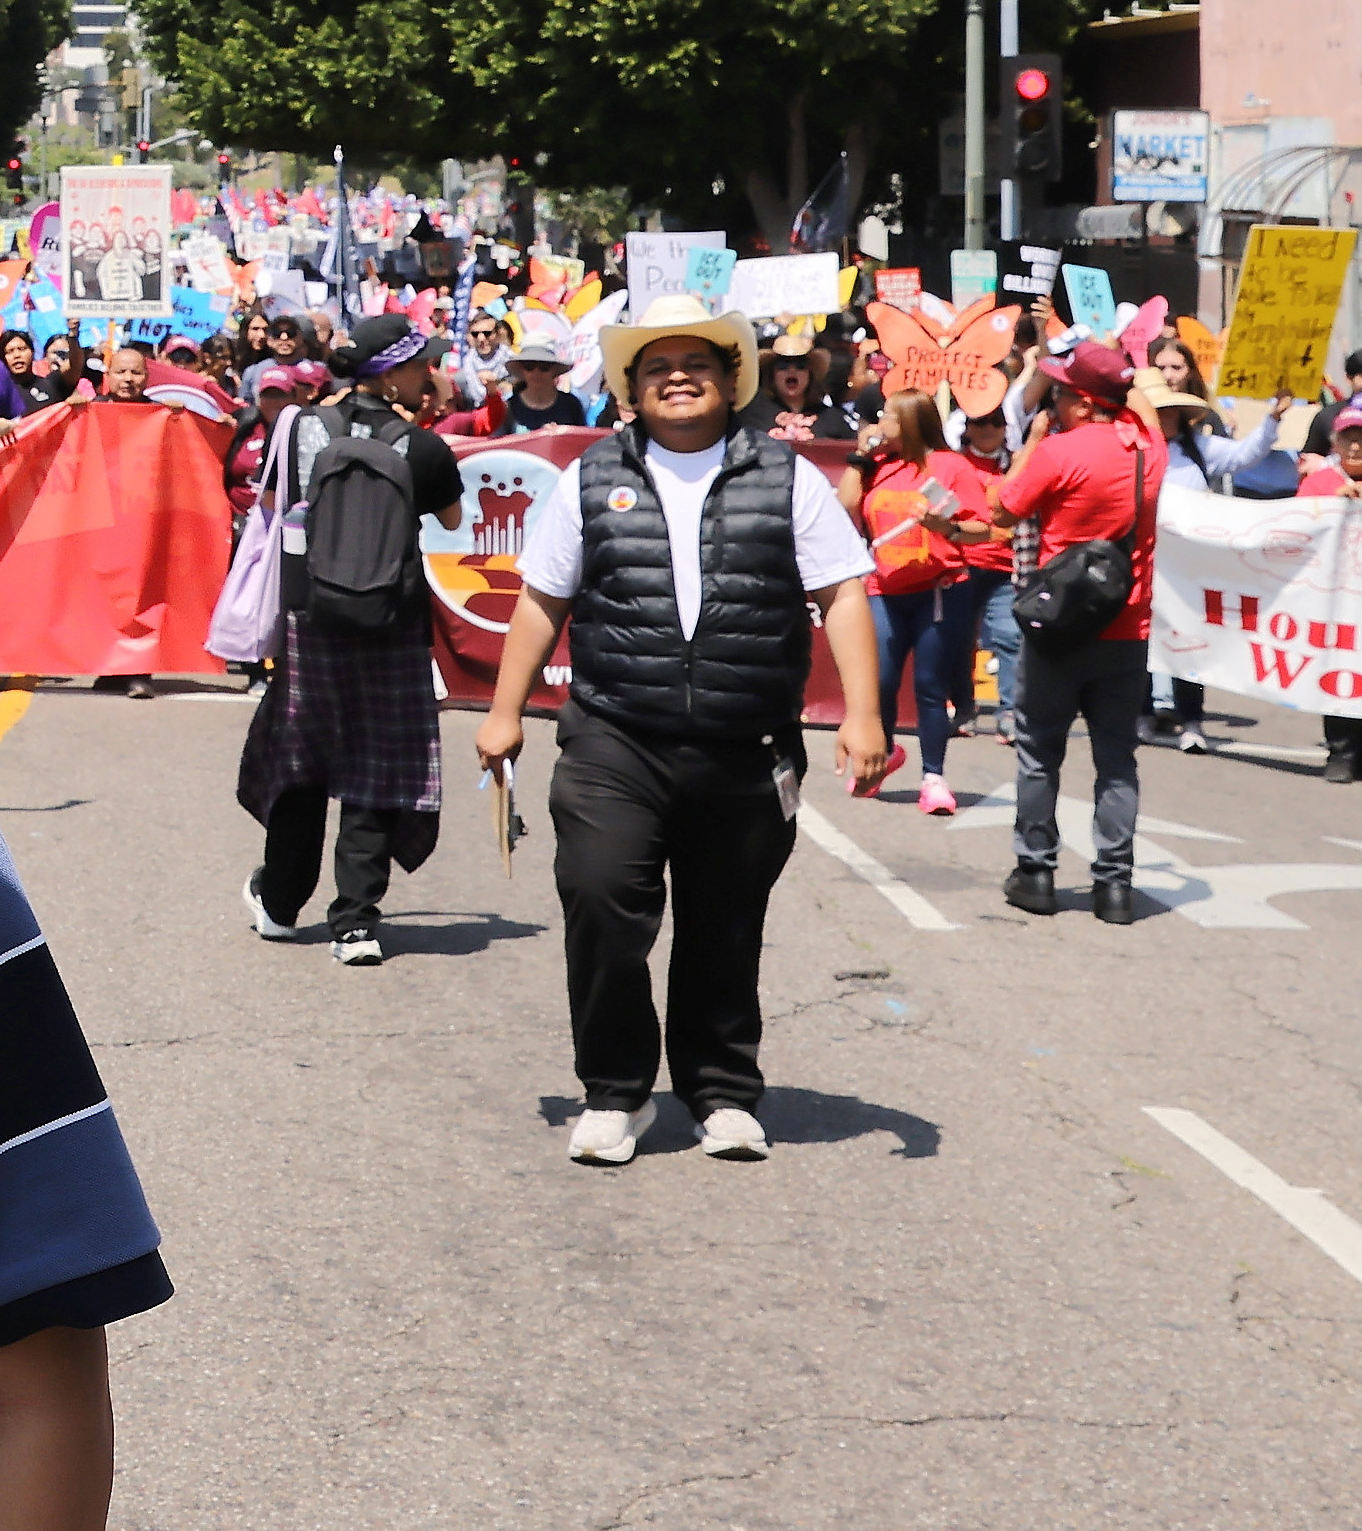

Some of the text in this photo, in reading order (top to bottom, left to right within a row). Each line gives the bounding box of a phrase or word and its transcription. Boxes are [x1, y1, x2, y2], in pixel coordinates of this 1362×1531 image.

[1116, 135, 1204, 158] MARKET
[701, 251, 722, 267] ICE
[907, 346, 983, 368] PROTECT
[904, 369, 989, 390] FAMILIES
